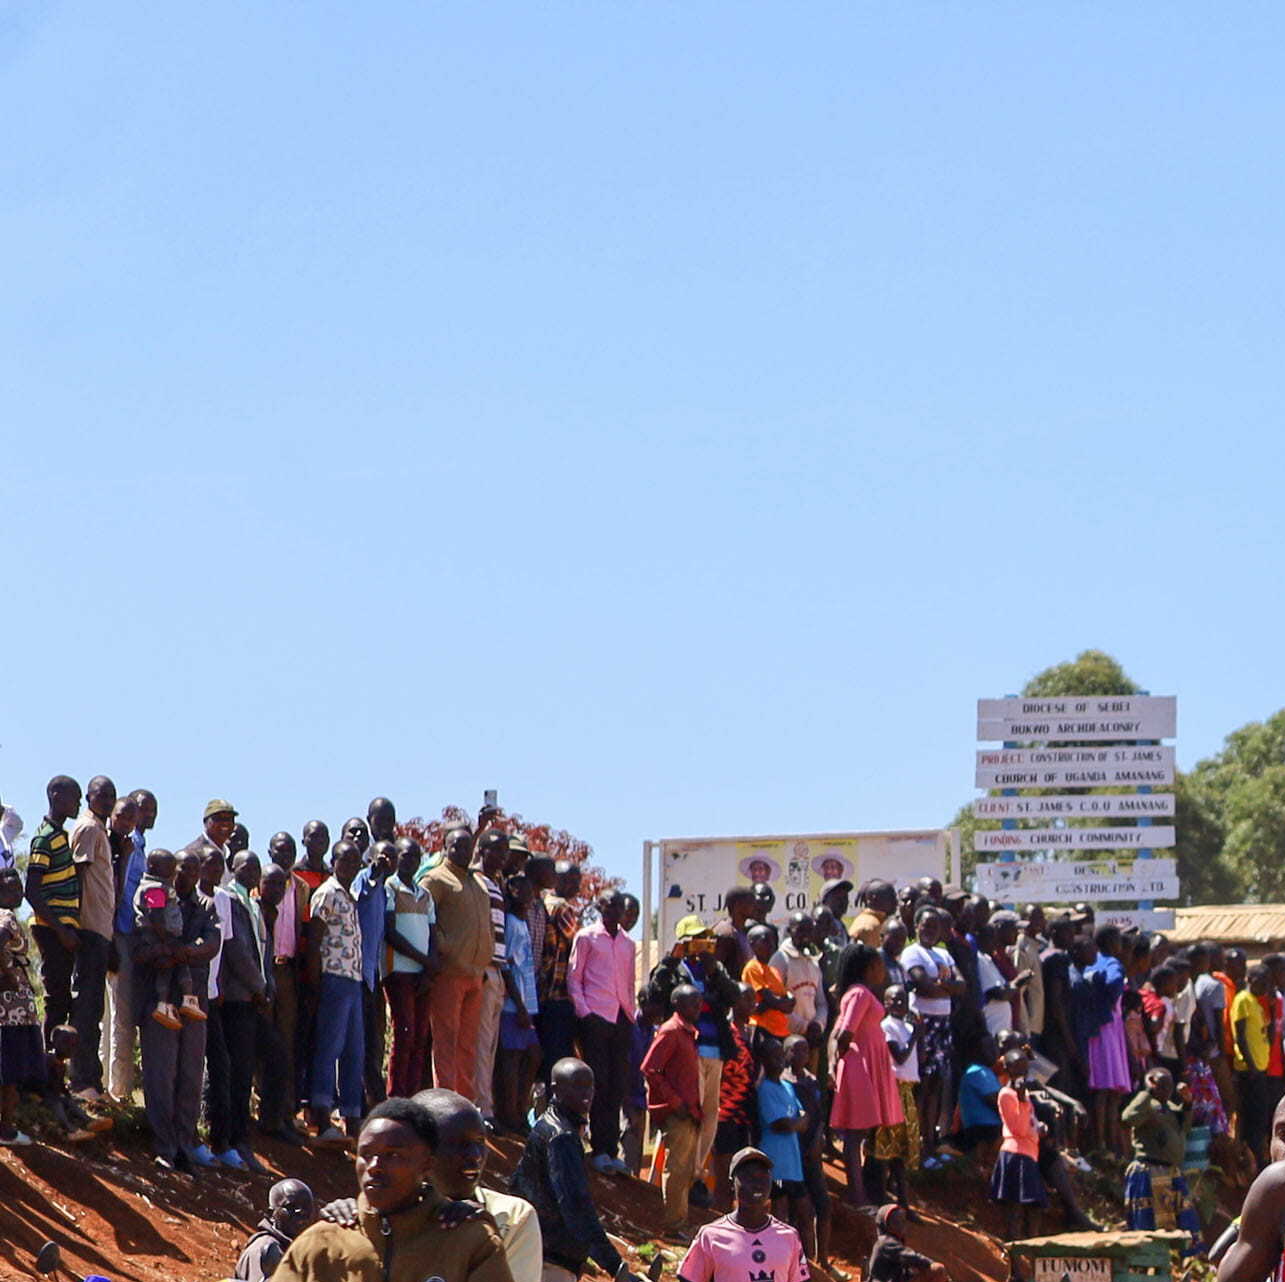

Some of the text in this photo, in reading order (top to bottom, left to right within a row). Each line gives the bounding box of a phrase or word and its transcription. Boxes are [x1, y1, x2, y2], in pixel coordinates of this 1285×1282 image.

[1022, 703, 1066, 714] DIOCESE
[1075, 703, 1088, 713] OF
[1030, 752, 1099, 763] CONSTRUCTION
[1099, 752, 1108, 762] OF
[1132, 751, 1162, 762] JAMES
[995, 770, 1165, 784] CHURCH OF UGANDA AMANANG
[1039, 802, 1073, 812] JAMES
[1118, 800, 1169, 811] AMANANG
[1030, 833, 1073, 844] CHURCH
[1079, 832, 1142, 843] COMMUNITY
